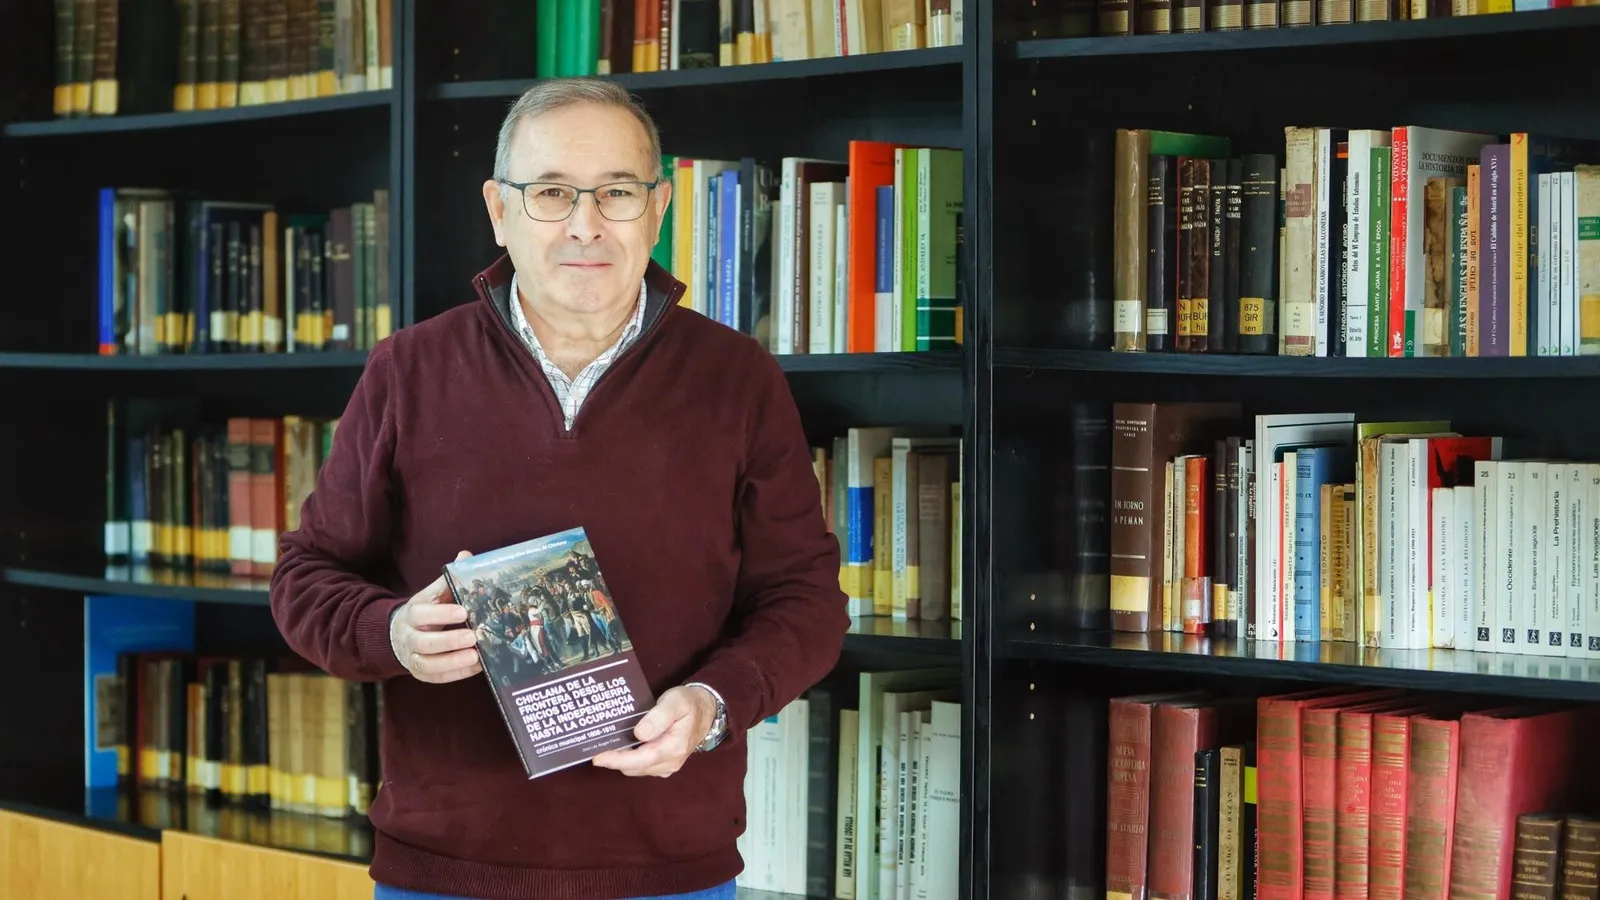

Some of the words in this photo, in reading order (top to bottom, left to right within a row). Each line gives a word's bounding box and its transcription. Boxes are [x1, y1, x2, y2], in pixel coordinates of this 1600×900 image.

[1422, 152, 1464, 164] DOCUMENTOS
[1418, 162, 1424, 170] LA
[1425, 162, 1454, 173] HISTORIA
[1458, 212, 1468, 250] ESPAÑA
[1342, 250, 1348, 258] DE
[1459, 250, 1468, 266] DE
[1470, 250, 1476, 261] DE
[816, 276, 823, 286] DE
[1515, 272, 1523, 280] El
[1459, 269, 1468, 313] LENGUAS
[1198, 302, 1204, 310] N
[1245, 313, 1258, 321] GIR
[1459, 314, 1468, 336] LAS
[1123, 501, 1144, 511] TORNO
[1120, 516, 1144, 526] PEMAN
[1553, 536, 1559, 547] La
[1532, 557, 1537, 566] en
[1464, 577, 1468, 586] DE
[515, 685, 566, 706] CHICLANA
[567, 680, 581, 691] DE
[582, 676, 596, 687] LA
[518, 693, 572, 715] FRONTERA
[572, 684, 605, 700] DESDE
[607, 676, 626, 689] LOS
[522, 706, 560, 724] INICIOS
[560, 701, 576, 713] DE
[576, 697, 590, 709] LA
[591, 685, 631, 704] GUERRA
[526, 722, 541, 733] DE
[542, 717, 557, 729] LA
[557, 694, 635, 724] INDEPENDENCIA
[530, 726, 564, 742] HASTA
[564, 720, 578, 732] LA
[578, 702, 635, 726] OCUPACIÓN
[536, 742, 559, 755] crónica
[559, 734, 587, 748] municipal
[587, 725, 616, 739] 1808-1810
[843, 851, 853, 867] MILLAN
[843, 868, 852, 878] SAN
